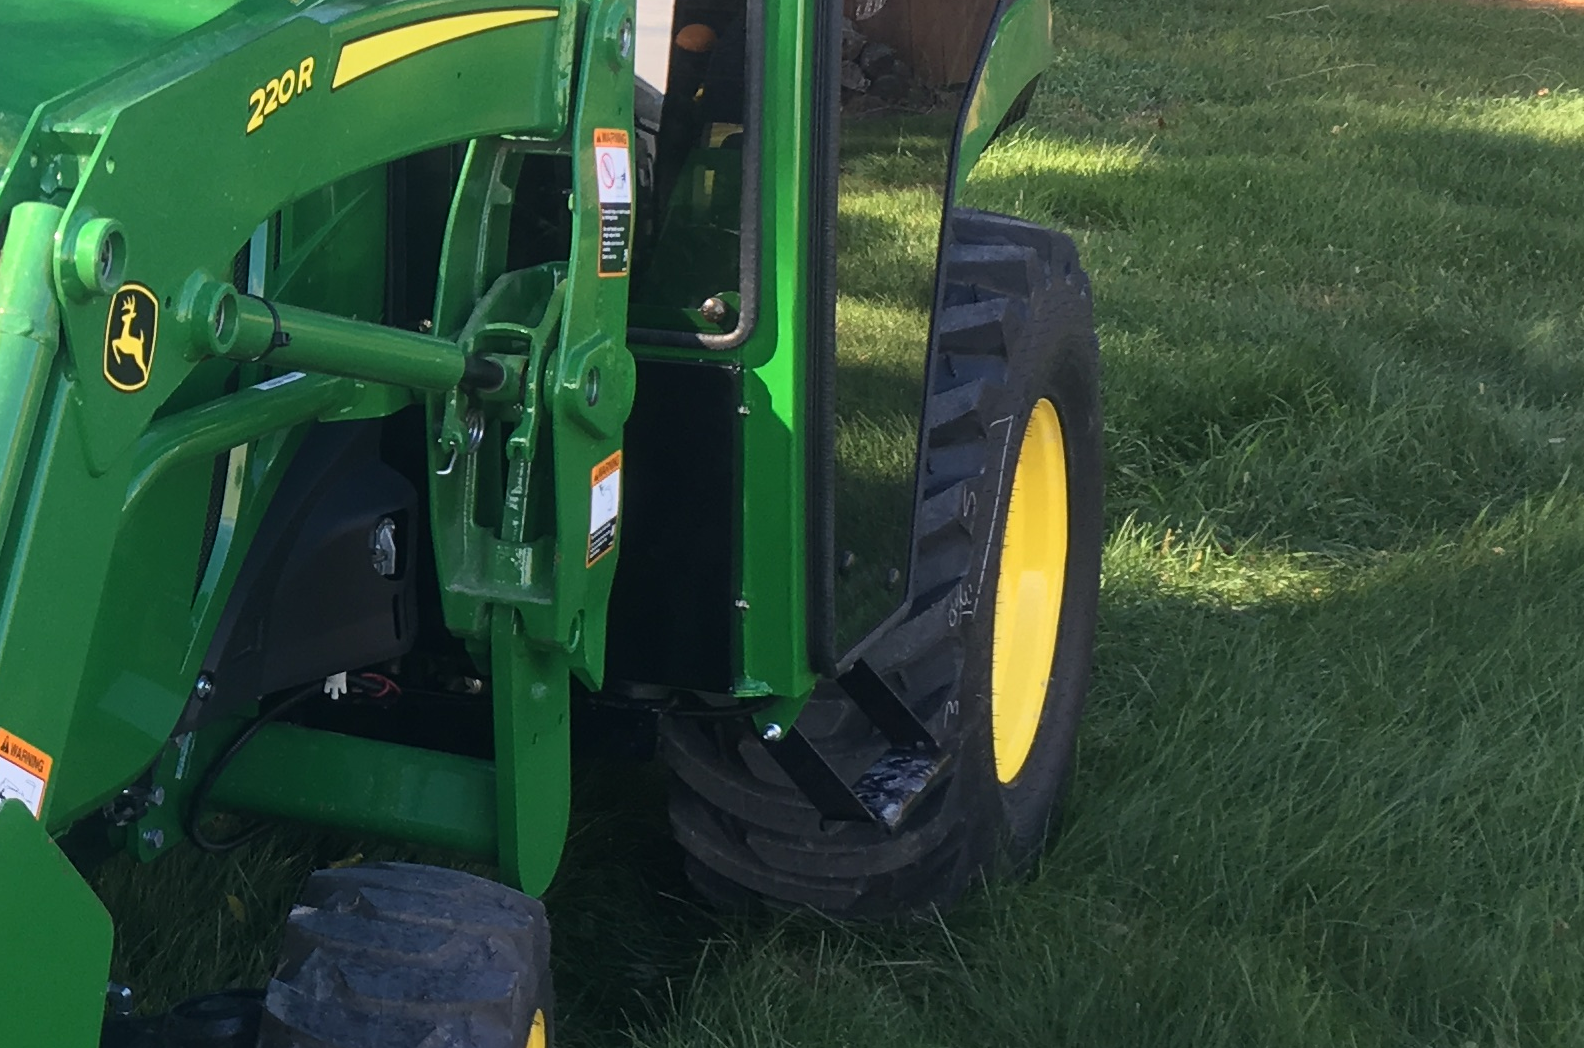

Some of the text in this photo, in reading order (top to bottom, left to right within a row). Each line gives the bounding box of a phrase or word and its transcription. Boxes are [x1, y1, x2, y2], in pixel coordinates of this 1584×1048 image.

[246, 56, 315, 134] 220R
[602, 131, 627, 145] WARNING
[10, 742, 45, 773] WARNING
